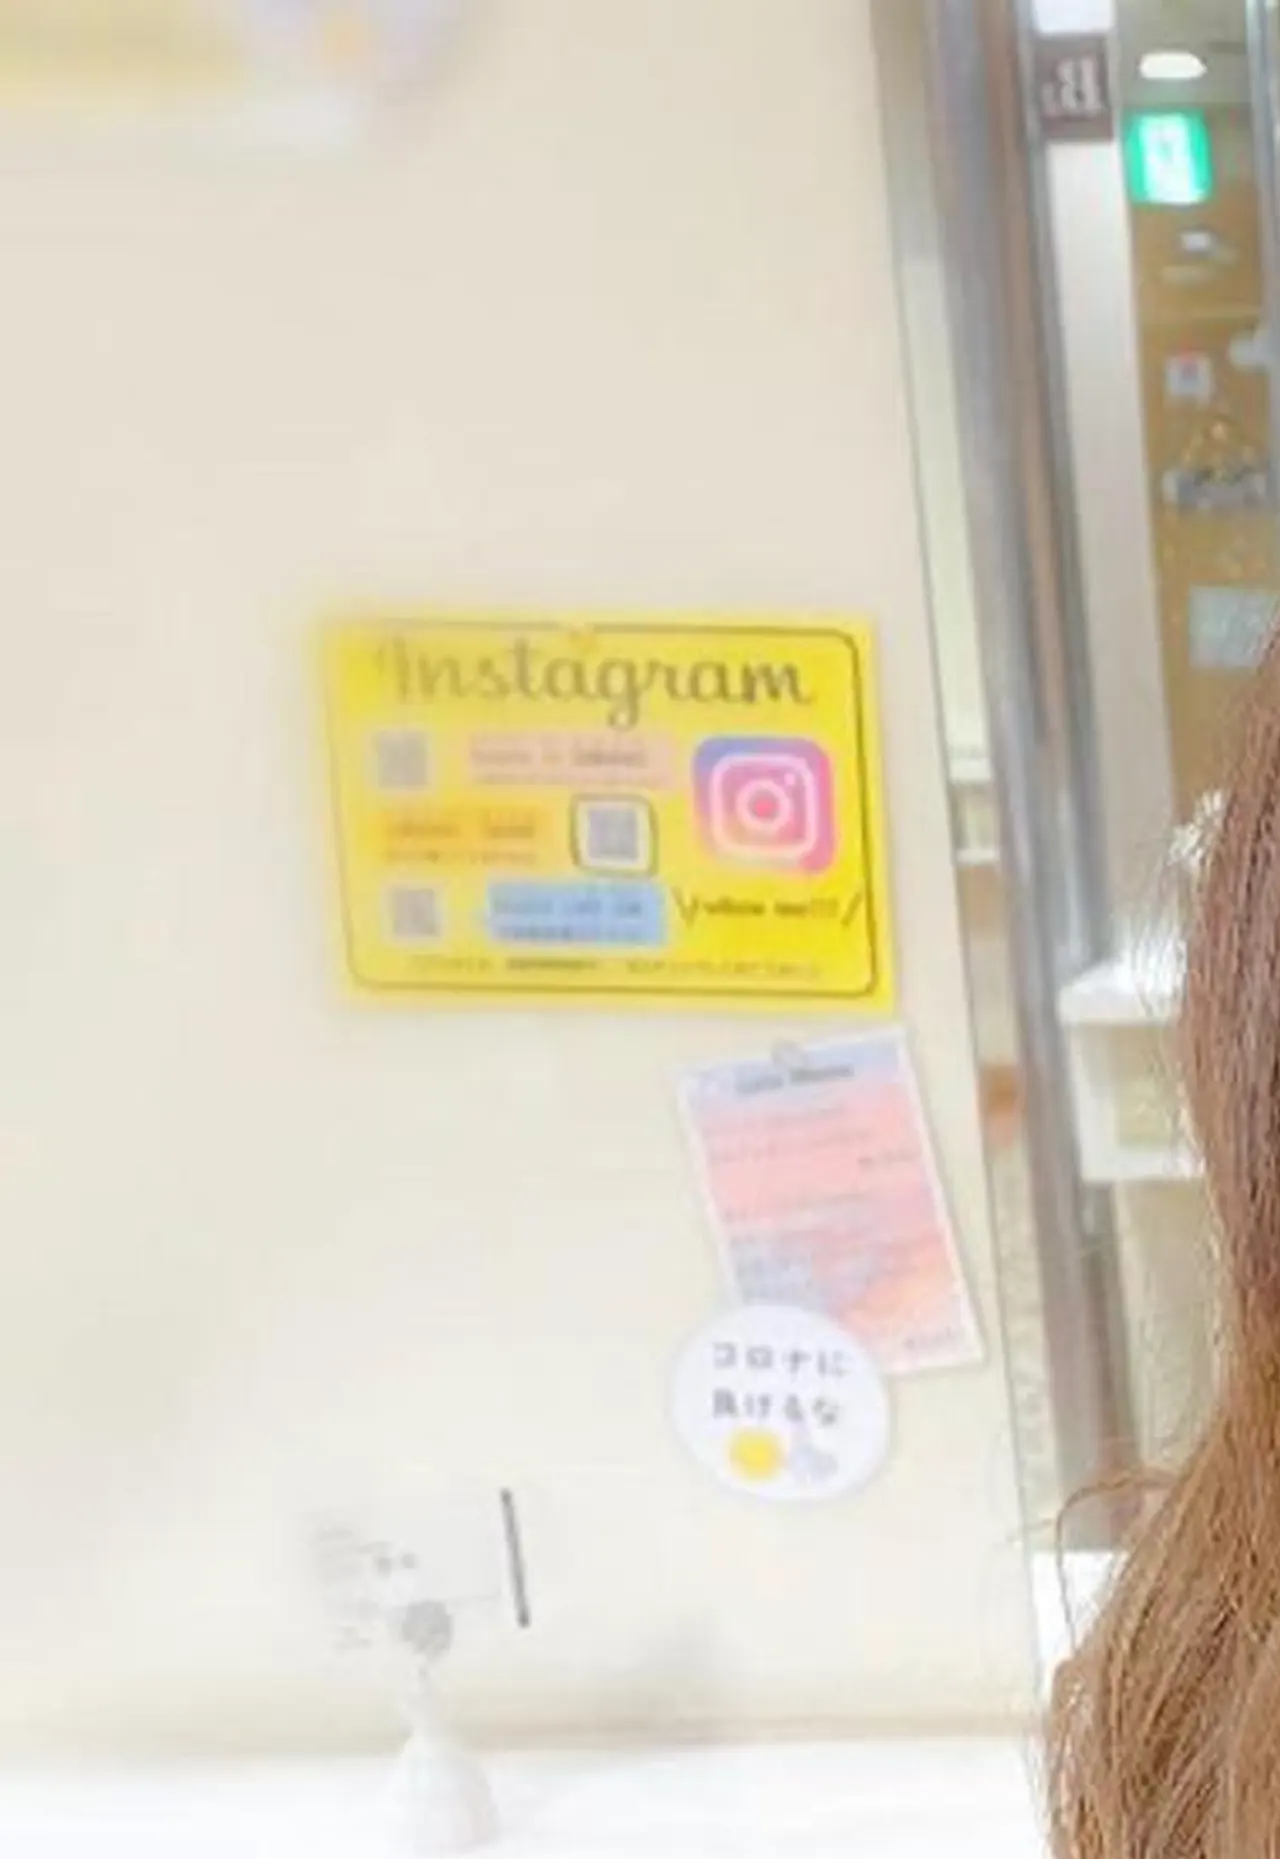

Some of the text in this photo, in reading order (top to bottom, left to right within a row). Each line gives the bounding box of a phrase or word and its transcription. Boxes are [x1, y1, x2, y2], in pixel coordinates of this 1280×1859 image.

[378, 636, 812, 731] Instagram
[712, 1340, 850, 1382] コロナに
